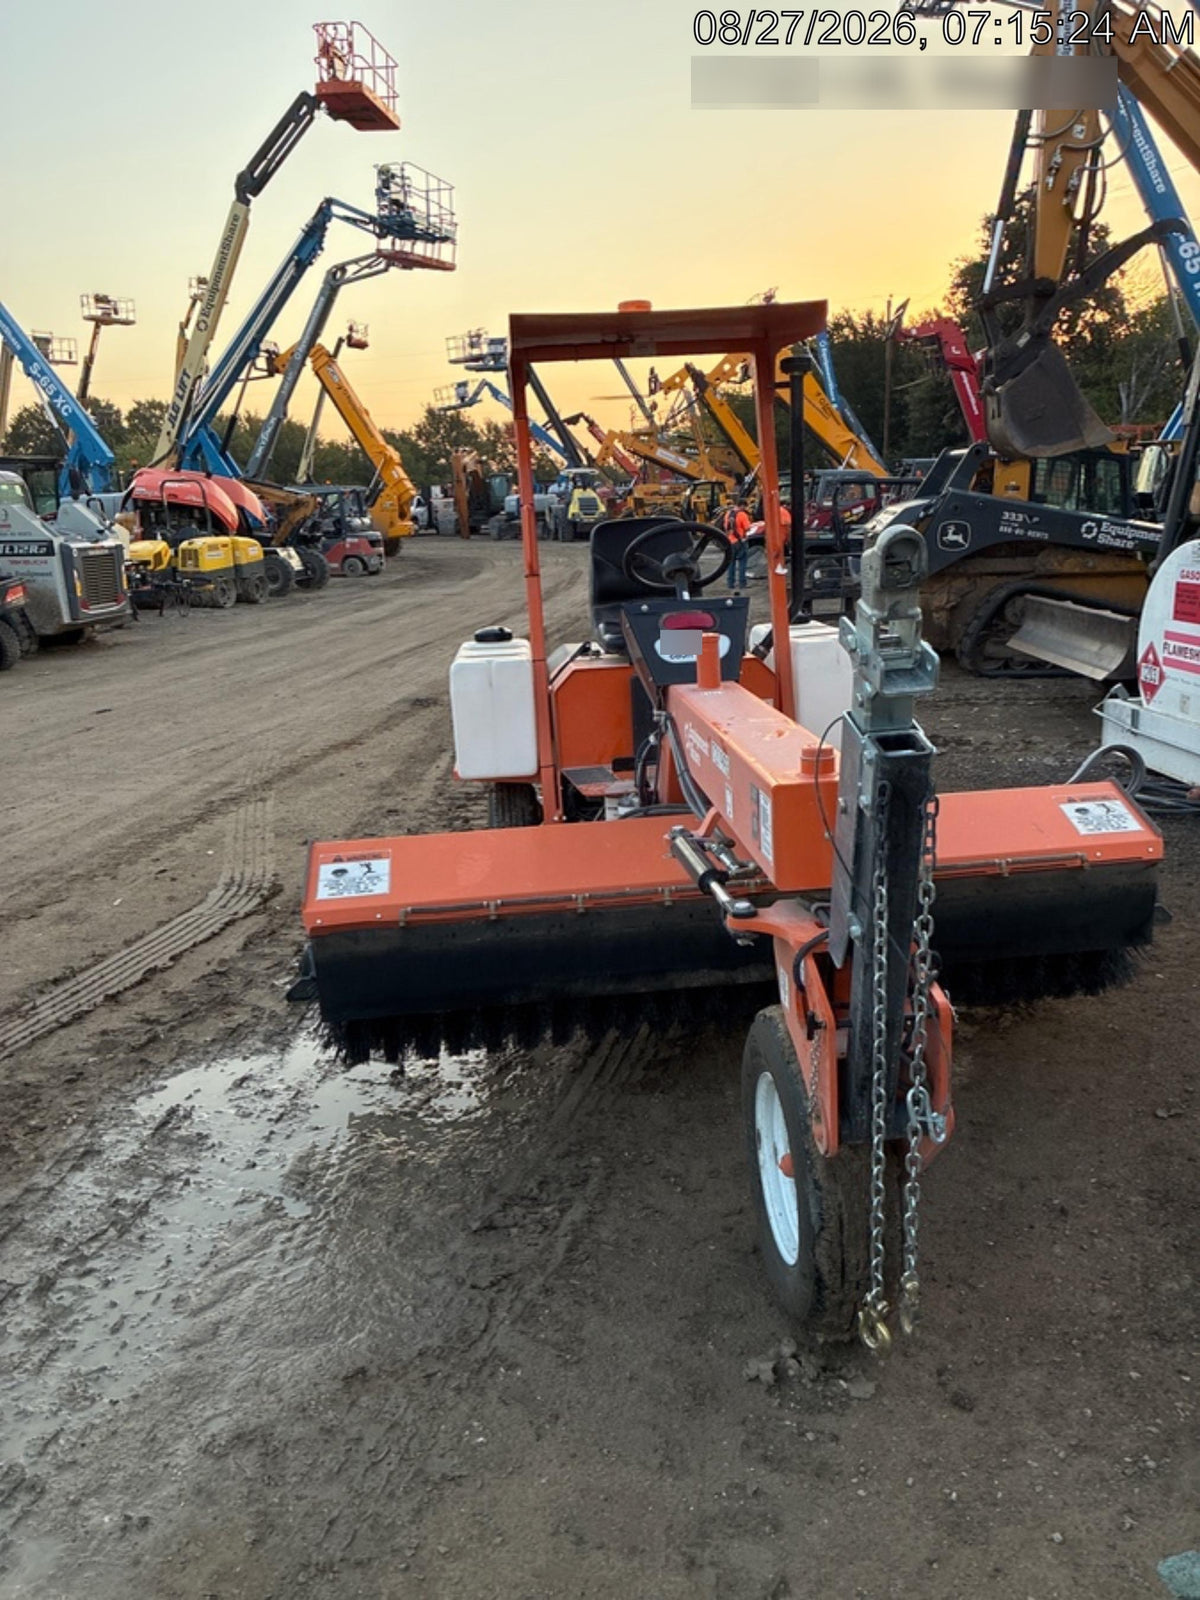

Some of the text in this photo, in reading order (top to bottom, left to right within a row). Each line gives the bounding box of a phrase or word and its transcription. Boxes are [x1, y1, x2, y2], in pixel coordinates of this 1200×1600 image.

[1173, 231, 1200, 275] -65
[29, 361, 73, 417] S-65 XC
[167, 368, 192, 429] JLG LIFT
[1001, 511, 1023, 522] 333
[1097, 533, 1136, 549] Share
